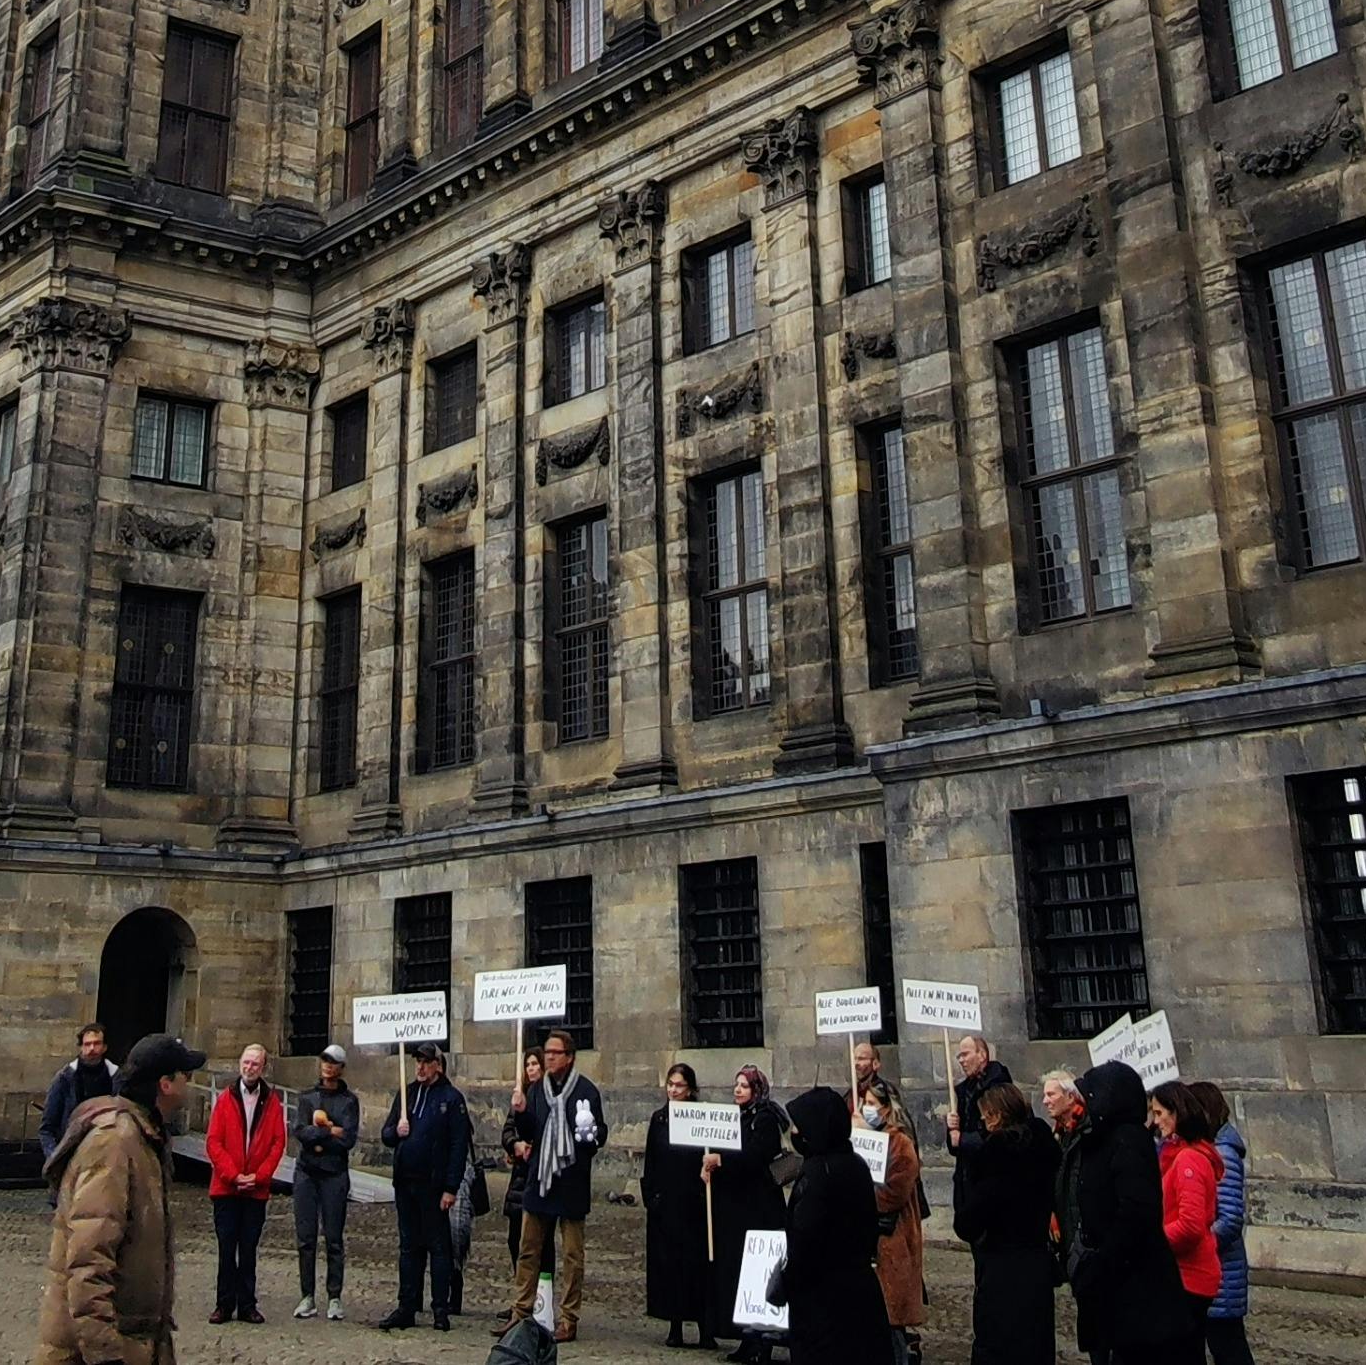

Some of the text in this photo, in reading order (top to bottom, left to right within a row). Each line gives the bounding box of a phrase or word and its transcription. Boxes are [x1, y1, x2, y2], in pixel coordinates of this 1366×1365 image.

[936, 990, 977, 1004] NEDERLAND
[495, 1003, 520, 1015] VOOR
[921, 1005, 944, 1018] DOET
[359, 1010, 446, 1023] NU DOORPAKKEN
[674, 1108, 738, 1122] WAAROM VERDER
[690, 1126, 738, 1140] UITSTELLEN
